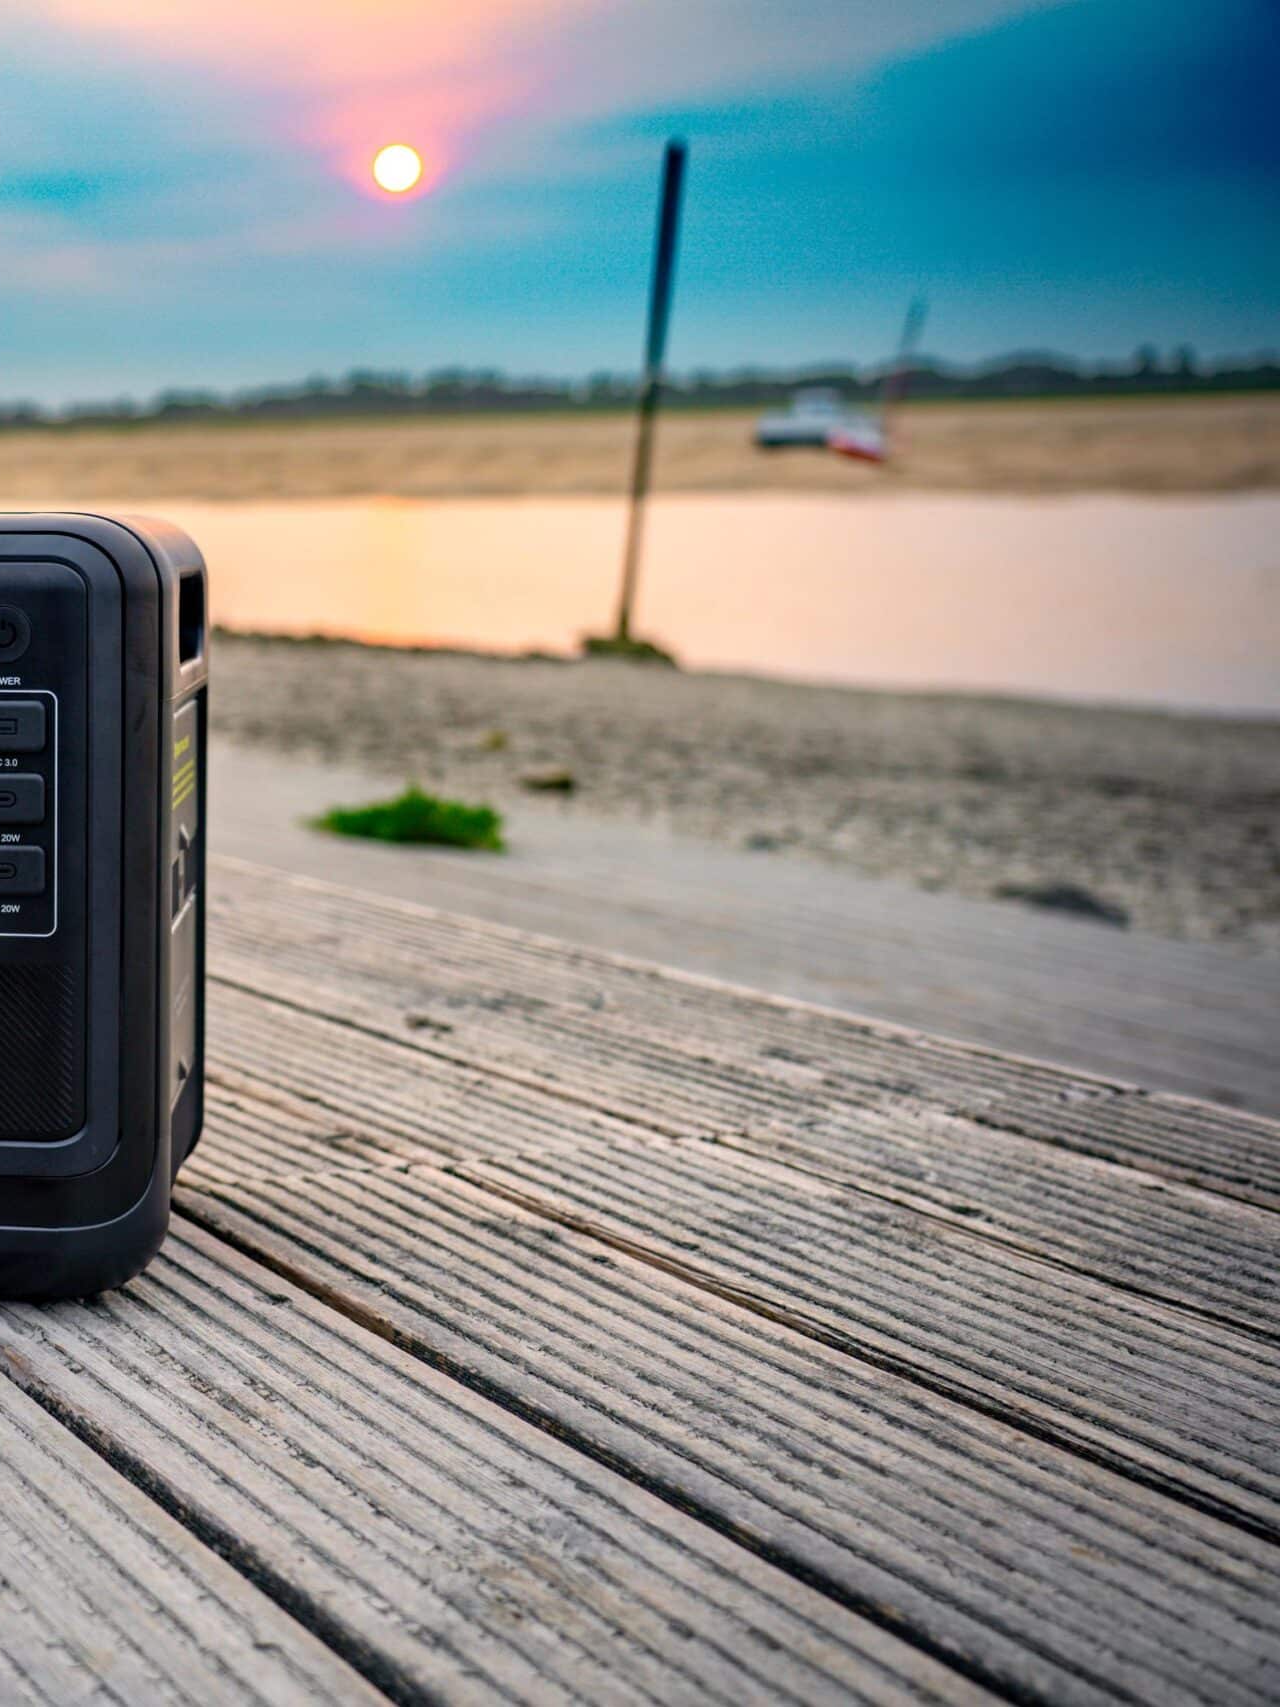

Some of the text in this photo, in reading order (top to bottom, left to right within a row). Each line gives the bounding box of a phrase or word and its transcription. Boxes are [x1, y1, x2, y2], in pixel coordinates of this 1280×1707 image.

[4, 758, 18, 767] 3.0
[1, 833, 21, 843] 20W
[1, 904, 21, 913] 20W
